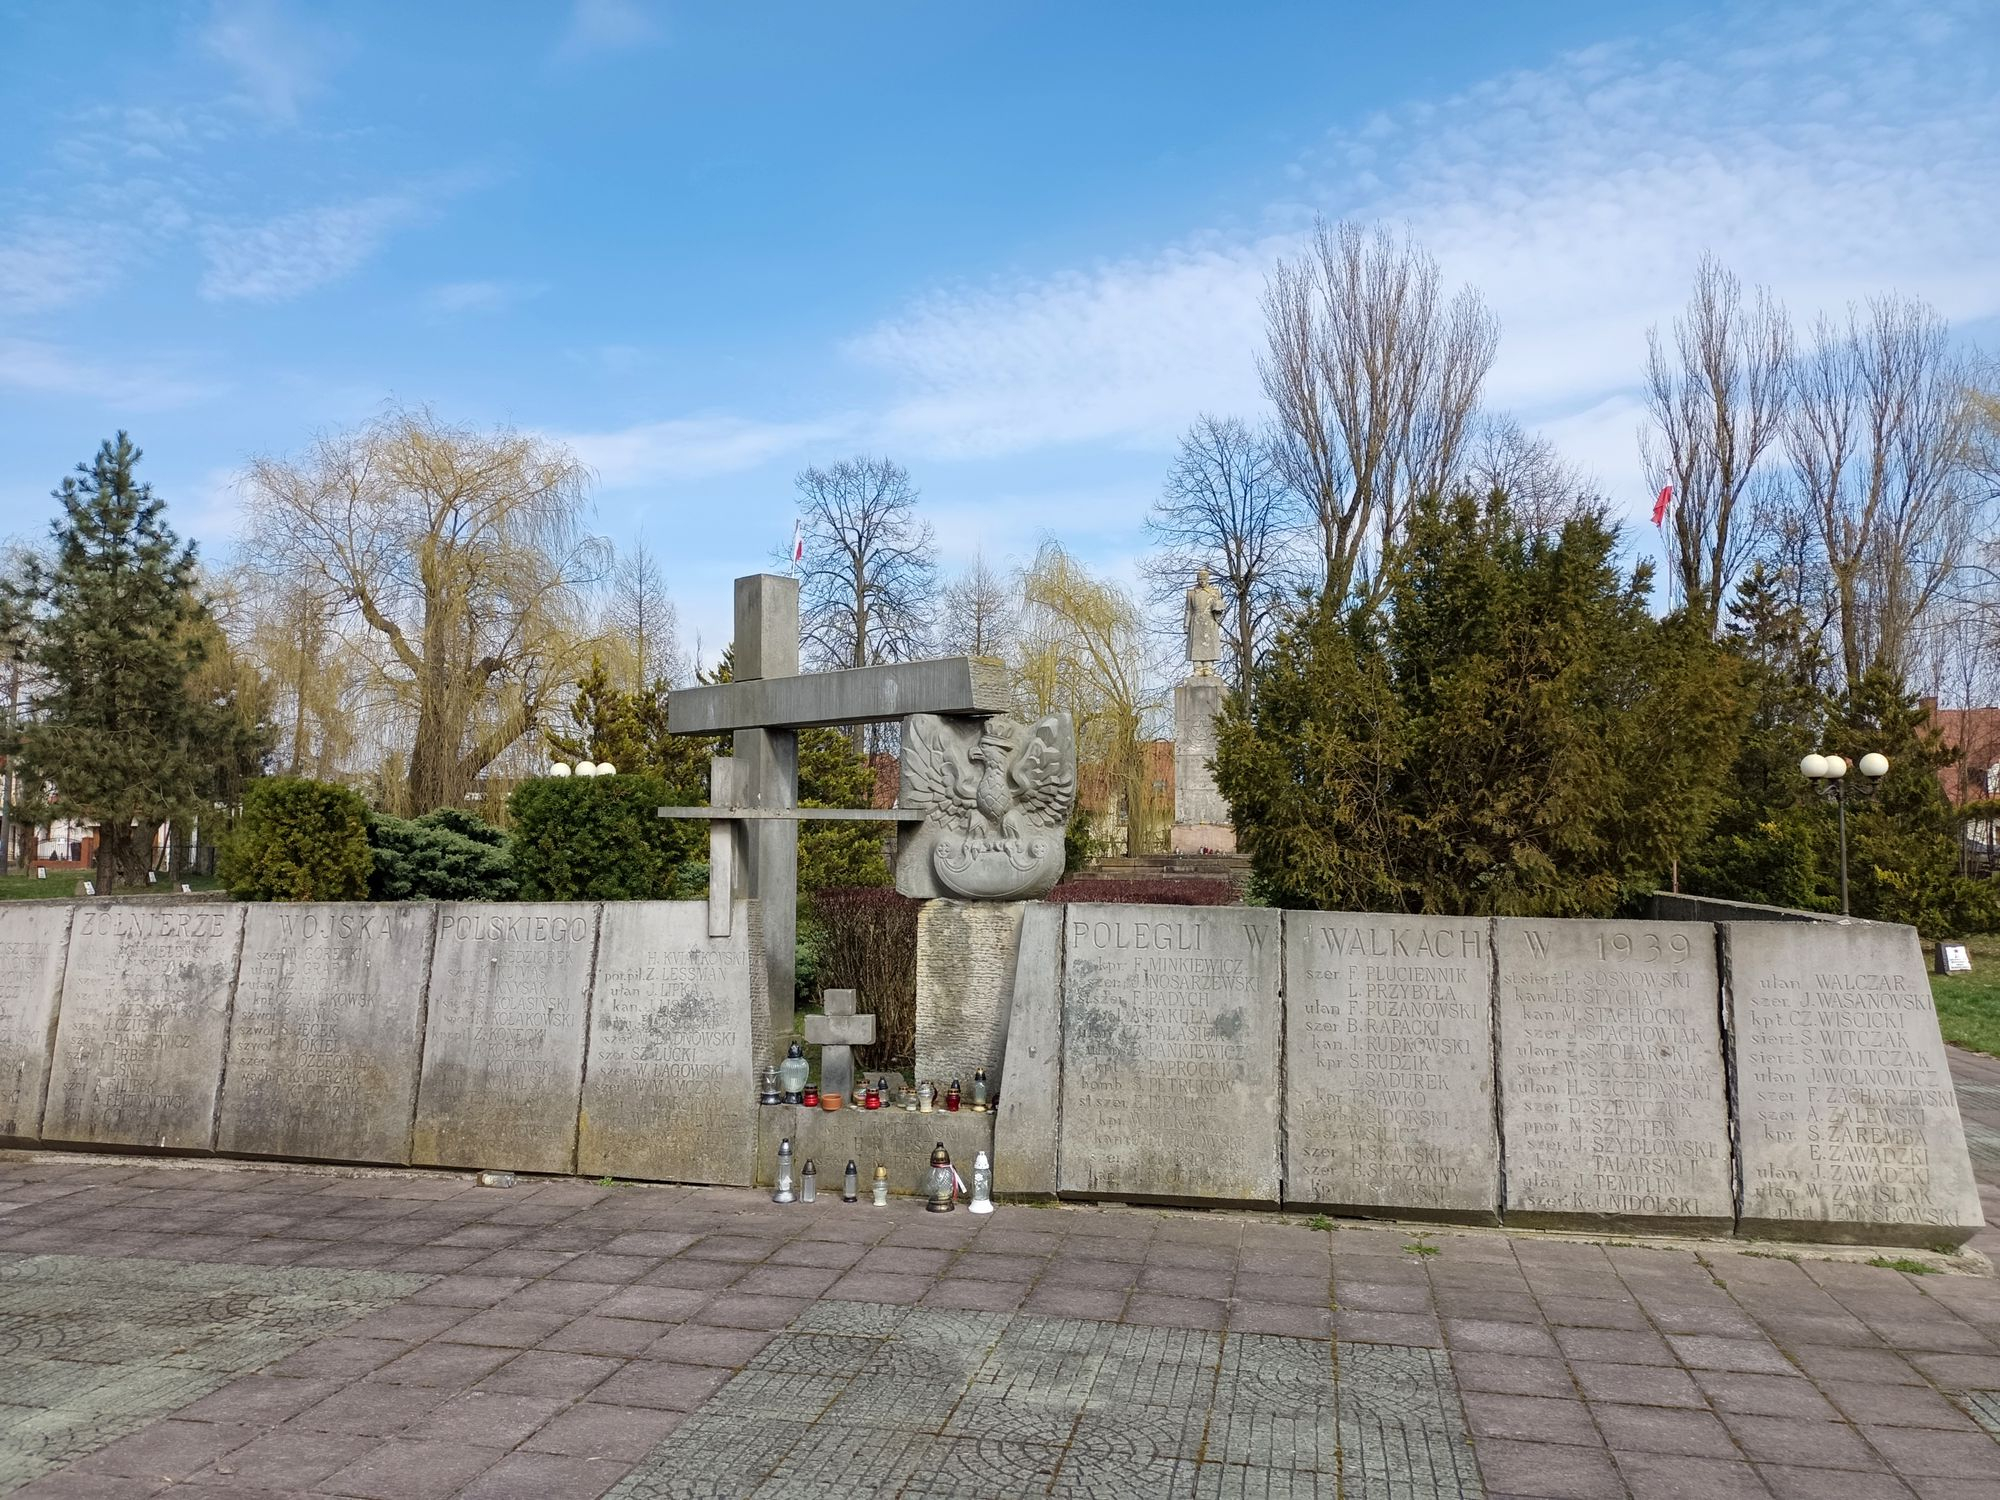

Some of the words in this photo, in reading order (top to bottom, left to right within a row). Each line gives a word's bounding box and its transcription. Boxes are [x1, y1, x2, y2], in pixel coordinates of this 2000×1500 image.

[279, 915, 392, 939] WOJSKA
[441, 915, 587, 942] POLSKIEGO
[1073, 922, 1201, 950] POLEGLI
[1243, 924, 1269, 951] W
[1321, 927, 1481, 958] WALKACH
[1524, 930, 1552, 960] W
[1595, 933, 1691, 964] 1939
[1149, 957, 1243, 974] MINKIEWICZ
[1815, 974, 1907, 991] WALCZAR
[1149, 991, 1209, 1007] PADYCH
[1366, 1019, 1441, 1036] RAPACKI
[1789, 1010, 1817, 1027] CZ.
[1819, 1030, 1910, 1049] WITCZAK
[1367, 1053, 1430, 1071] RUDZIK
[1822, 1049, 1930, 1068] WOJTCZAK
[1364, 1071, 1449, 1090] SADUREK
[1827, 1106, 1927, 1126] ZALEWSKI
[1591, 1118, 1676, 1137] SZPYTER
[1827, 1125, 1929, 1146] ZAREMBA
[1829, 1145, 1929, 1167] ZAWADZKI
[1830, 1164, 1931, 1186] ZAWADZKI
